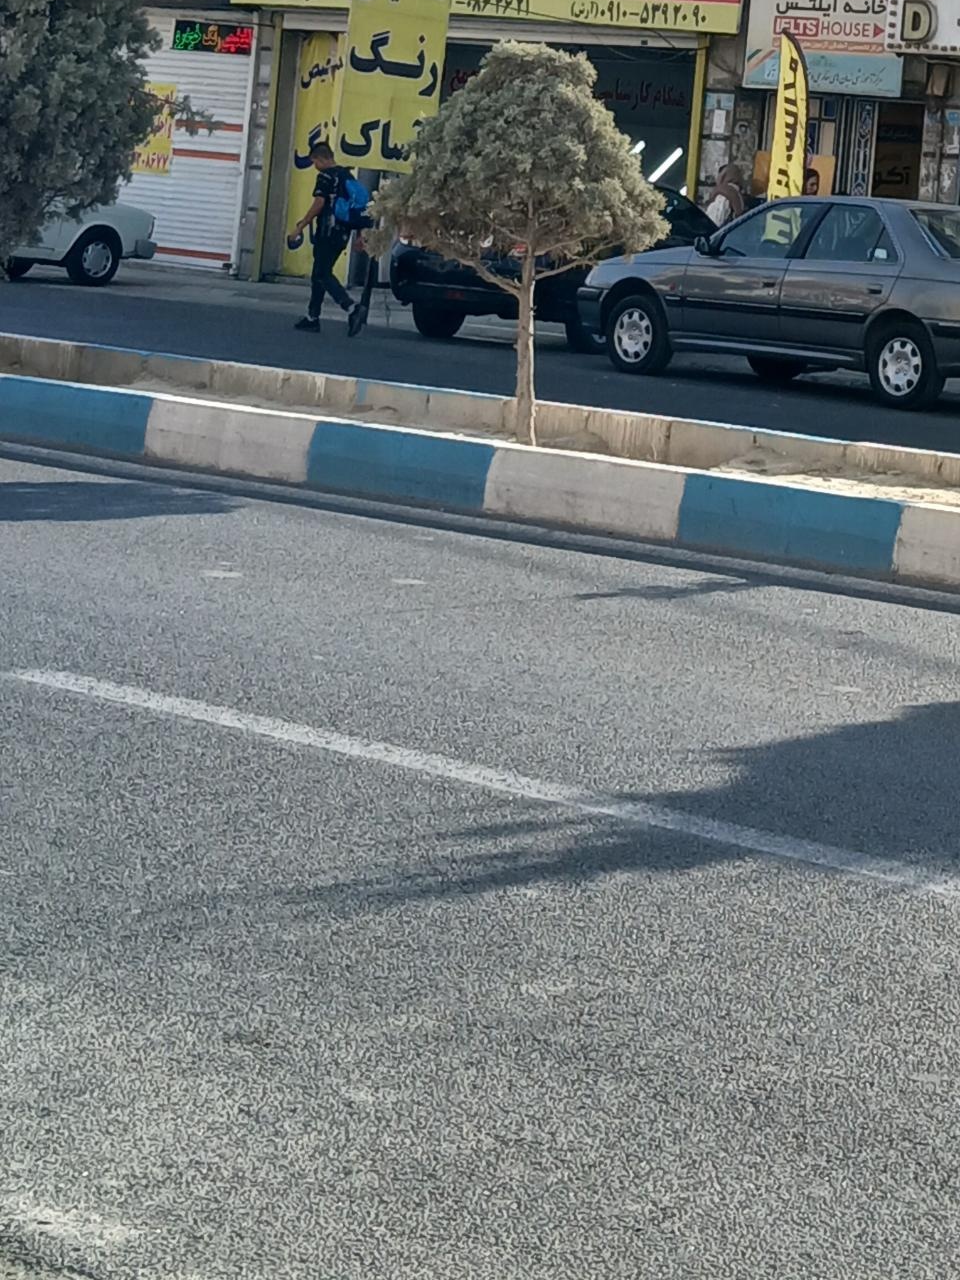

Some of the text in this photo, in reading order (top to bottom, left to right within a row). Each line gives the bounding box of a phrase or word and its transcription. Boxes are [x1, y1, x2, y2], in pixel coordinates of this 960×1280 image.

[774, 18, 871, 38] IELTS HOUSE
[349, 30, 439, 97] رنگ
